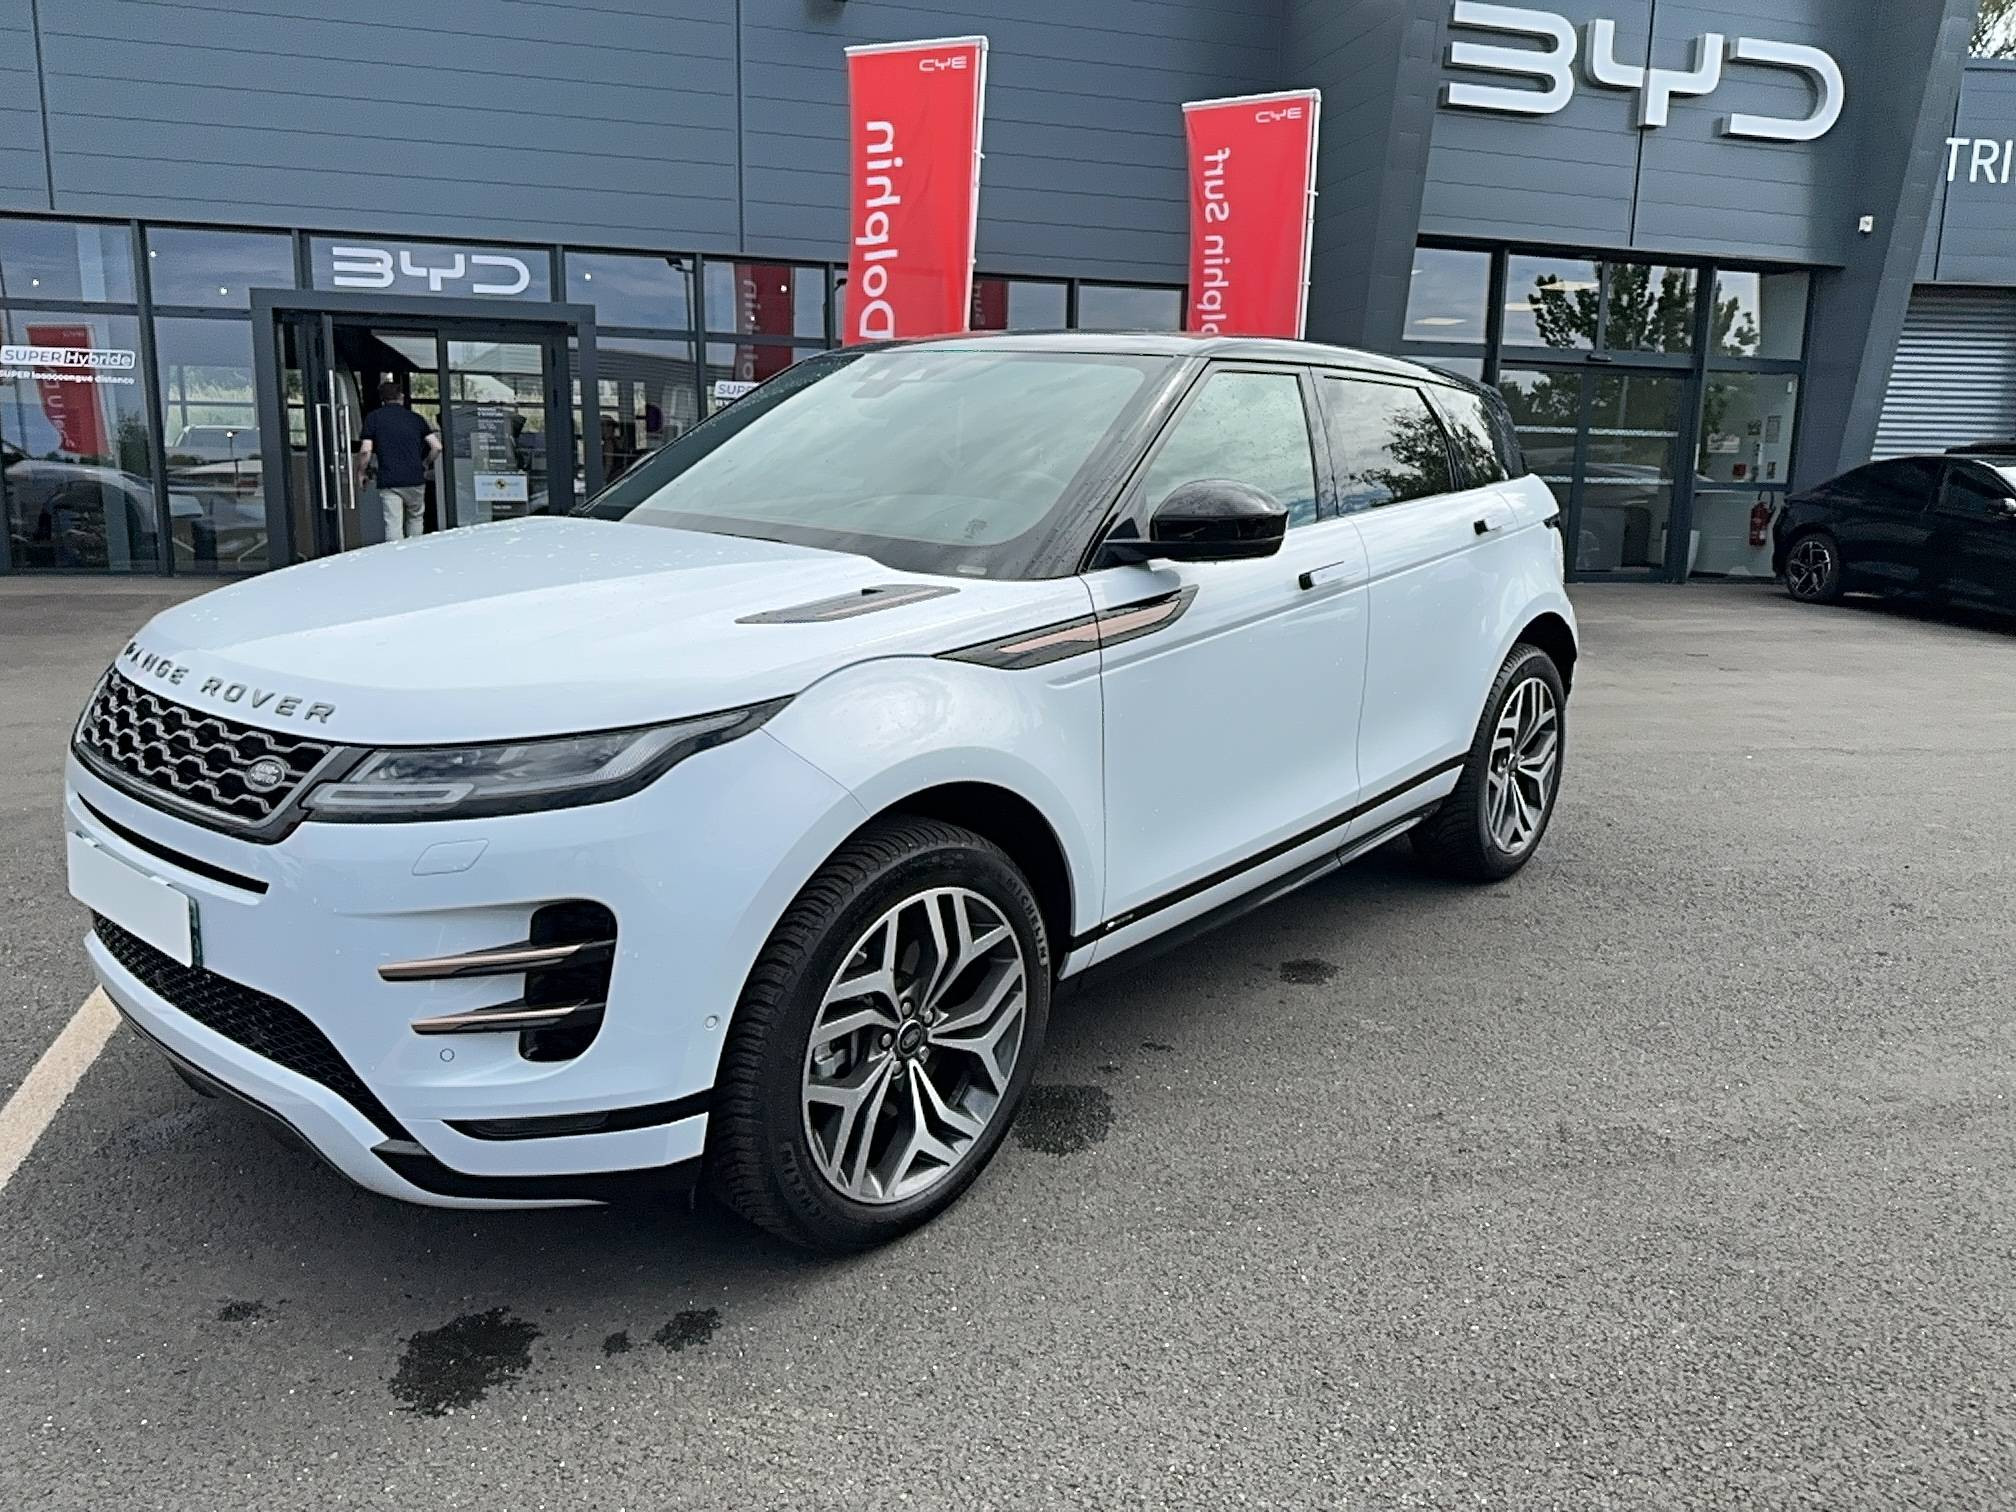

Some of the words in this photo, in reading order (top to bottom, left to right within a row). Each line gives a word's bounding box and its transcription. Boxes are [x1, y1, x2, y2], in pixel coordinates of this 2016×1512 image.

[1443, 0, 1844, 141] BYD
[1946, 137, 2016, 184] TRI
[332, 246, 530, 295] BYD
[3, 349, 62, 363] SUPER
[66, 351, 132, 367] Hybride
[718, 383, 754, 395] SUP
[200, 676, 336, 724] ROVER
